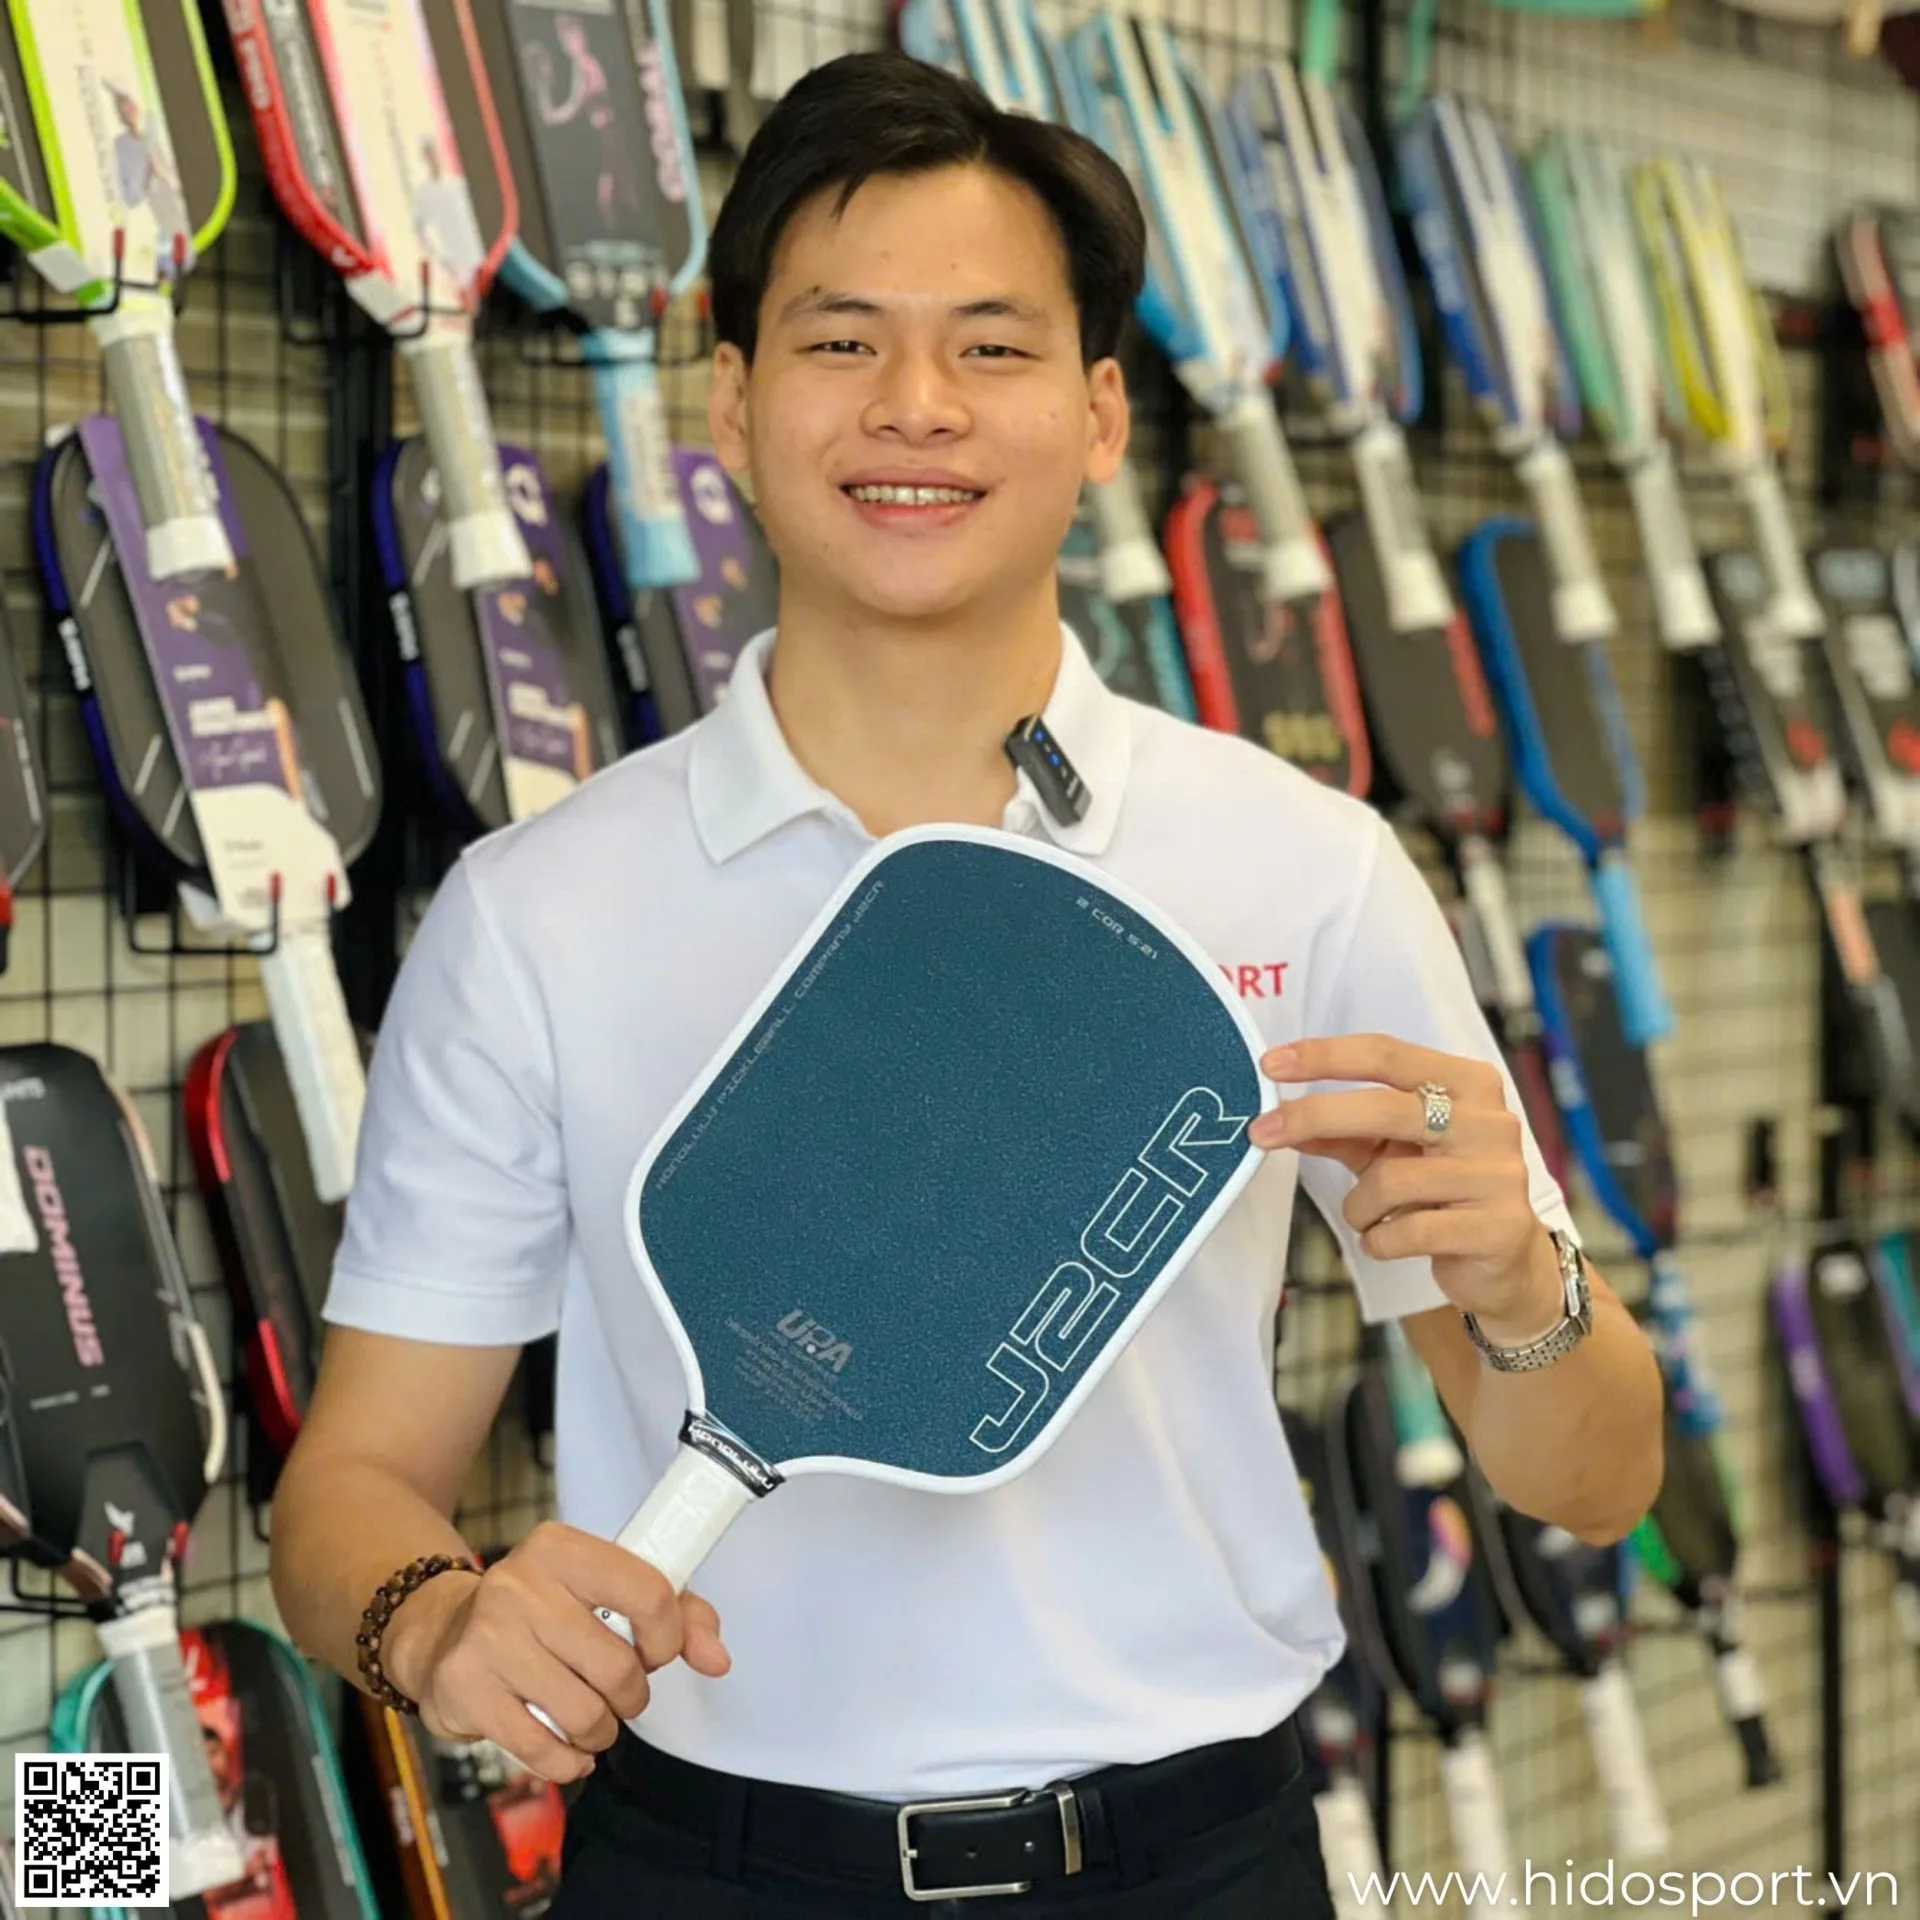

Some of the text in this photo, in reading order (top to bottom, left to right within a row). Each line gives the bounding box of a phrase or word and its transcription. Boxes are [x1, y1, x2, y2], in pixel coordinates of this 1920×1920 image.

[1091, 907, 1125, 934] COR
[717, 1000, 798, 1104] PICKLEBALL
[793, 922, 852, 999] COMPANY
[23, 1145, 104, 1367] DOMINUS
[776, 1308, 853, 1373] UPA
[969, 1086, 1249, 1452] J2CR
